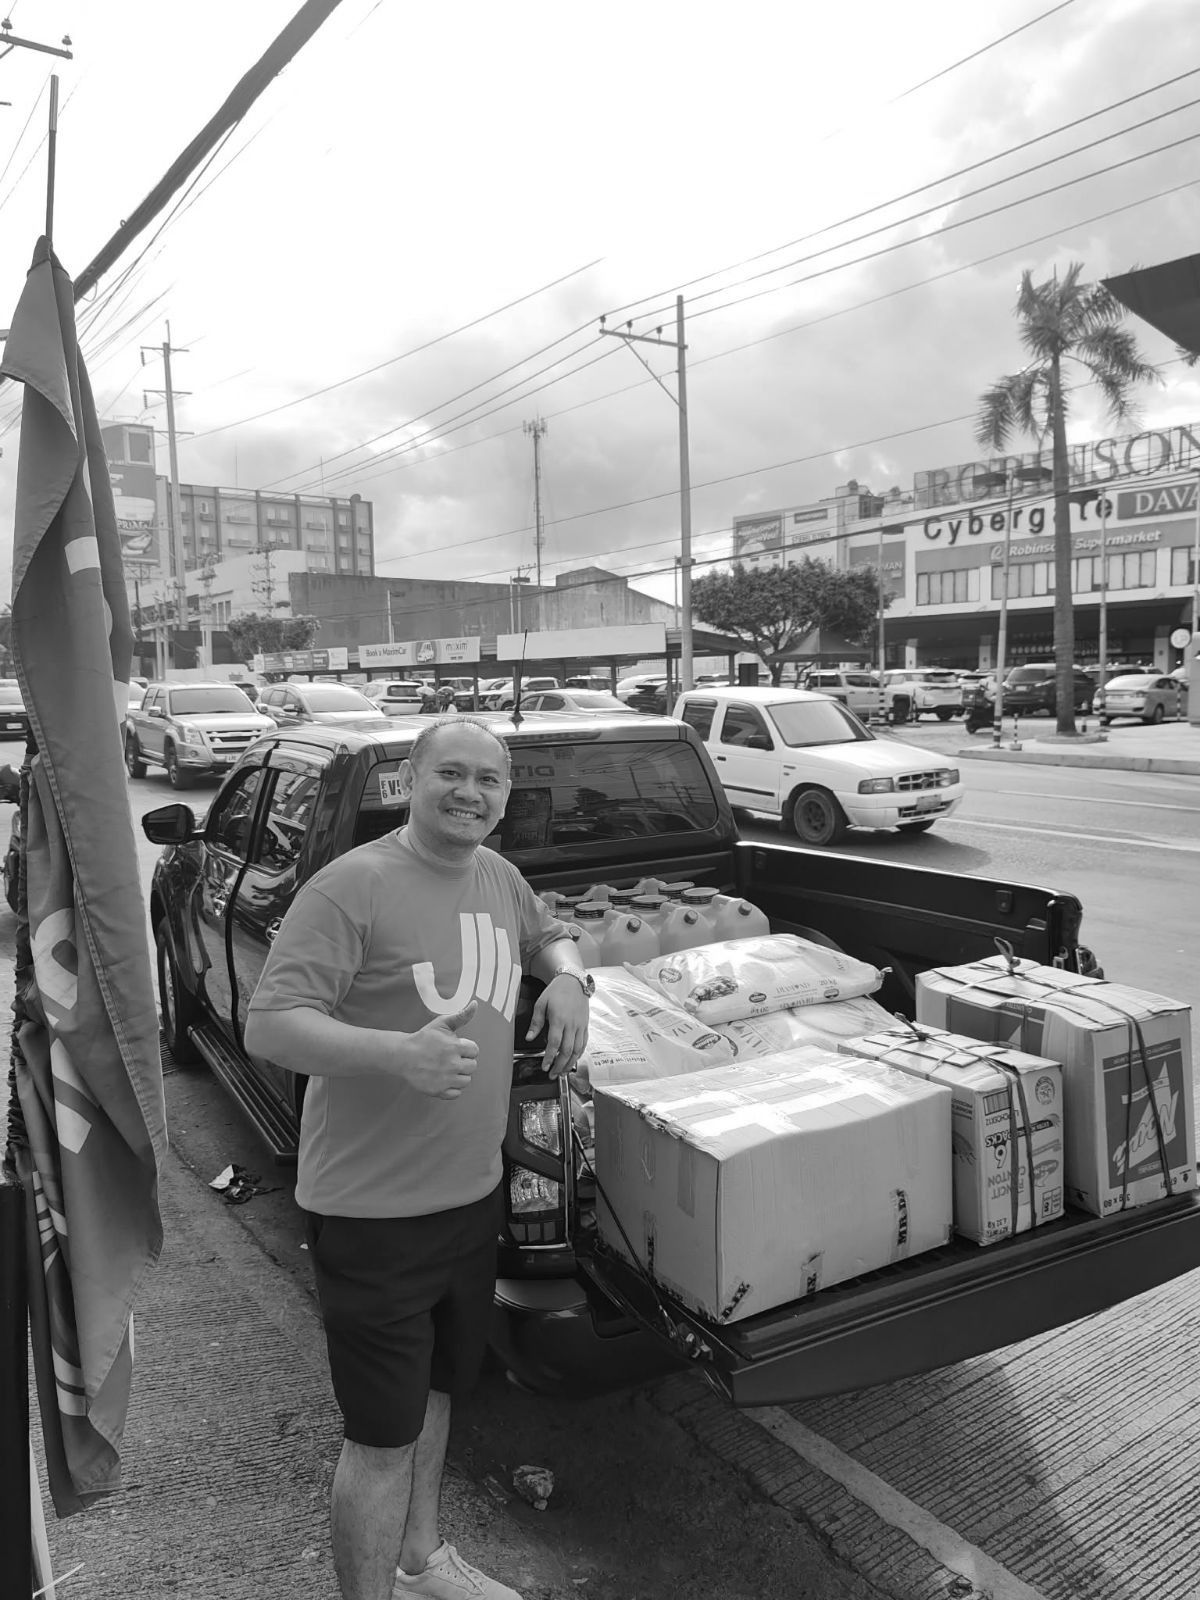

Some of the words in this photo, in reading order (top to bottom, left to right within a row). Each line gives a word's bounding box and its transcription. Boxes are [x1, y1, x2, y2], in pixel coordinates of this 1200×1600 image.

[923, 498, 1113, 544] Cybergte
[994, 1145, 1007, 1169] 6
[988, 1165, 1026, 1188] CNTON
[991, 1178, 1024, 1200] PNCIT
